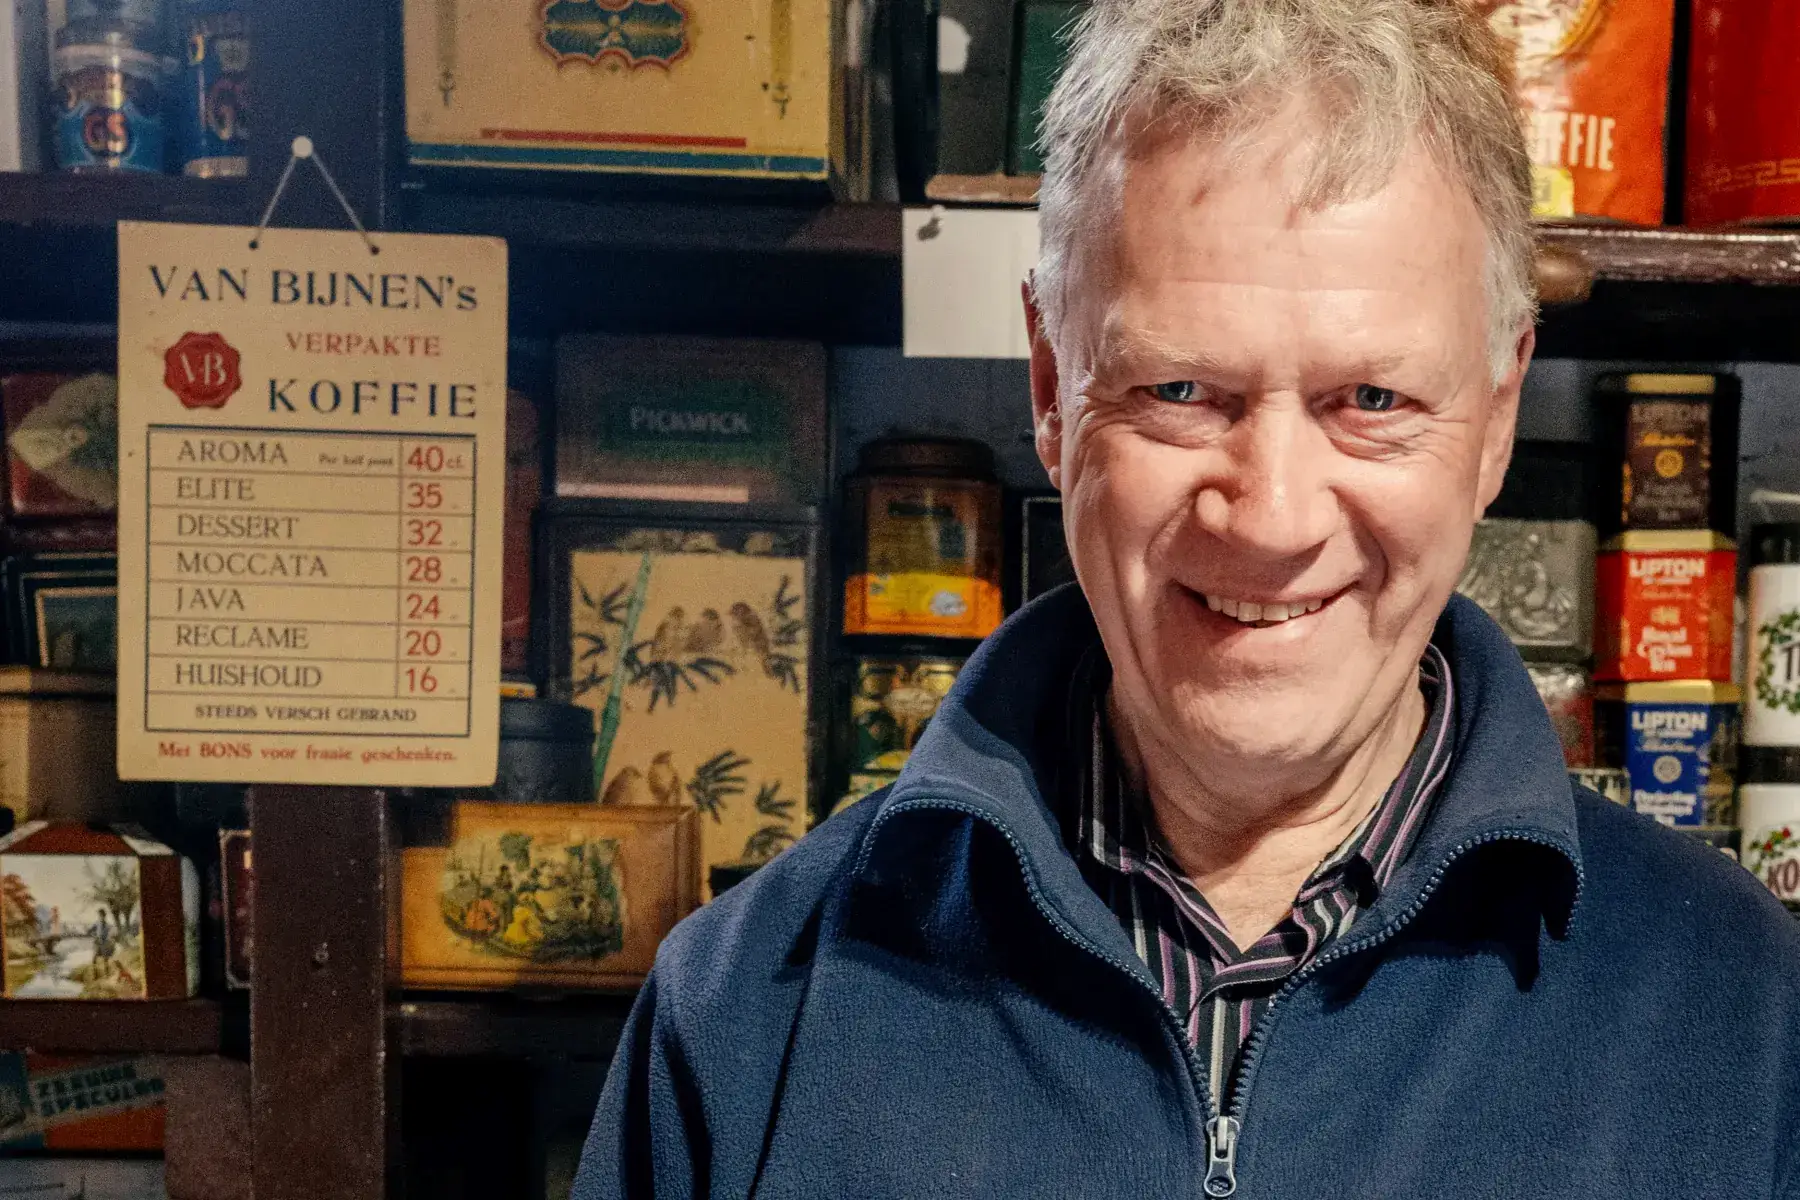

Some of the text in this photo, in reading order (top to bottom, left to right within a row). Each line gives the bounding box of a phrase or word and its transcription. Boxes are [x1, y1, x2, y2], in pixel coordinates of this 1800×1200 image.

[148, 264, 478, 311] VAN BIJNEN's
[286, 332, 441, 357] VERPAKTE
[268, 377, 477, 419] KOFFIE
[178, 439, 288, 464] AROMA
[407, 446, 445, 472] 40
[177, 476, 443, 509] ELITE 35
[177, 513, 443, 546] DESSERT 32
[177, 551, 442, 583] MOCCATA 28
[1629, 558, 1706, 578] LIPTON
[177, 587, 442, 620] JAVA 24
[176, 624, 442, 657] RECLAME 20
[175, 663, 438, 693] HUISHOUD 16
[196, 704, 417, 722] STEEDS VERSCH GEBRAND
[1631, 711, 1708, 731] LIPTON
[159, 741, 190, 757] Met
[199, 742, 252, 759] BONS
[260, 746, 297, 760] voor
